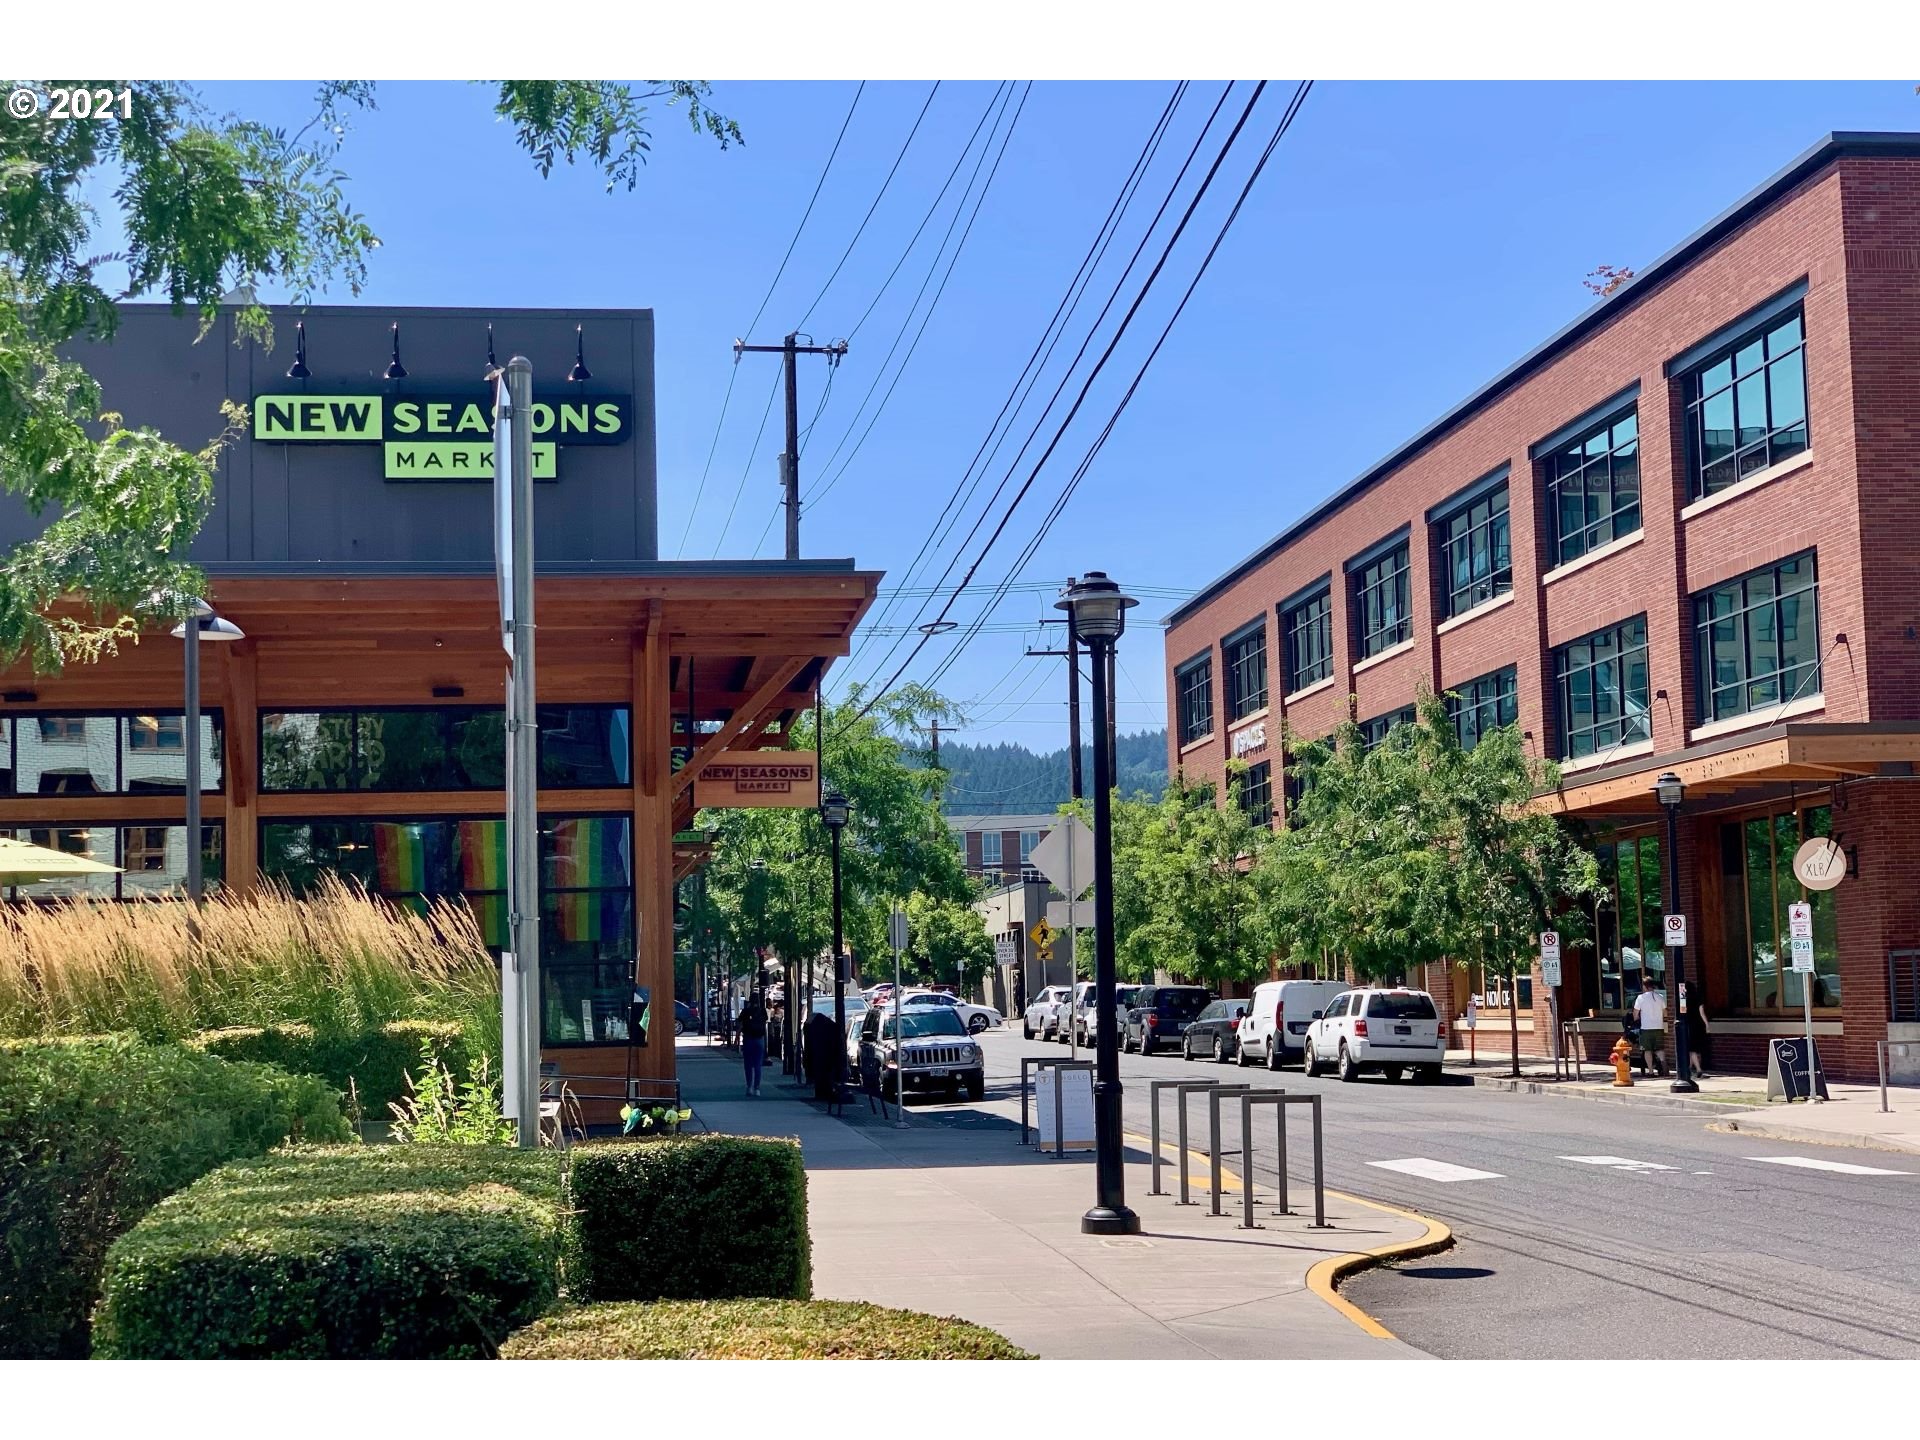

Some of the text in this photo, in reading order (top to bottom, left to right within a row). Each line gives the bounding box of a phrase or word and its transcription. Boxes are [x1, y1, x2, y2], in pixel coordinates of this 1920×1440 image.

[265, 402, 622, 434] NEW SEAONS
[396, 451, 545, 468] MARKT
[702, 767, 809, 778] NEW SEASONS
[740, 782, 787, 790] MARKET
[1806, 862, 1825, 877] XLB
